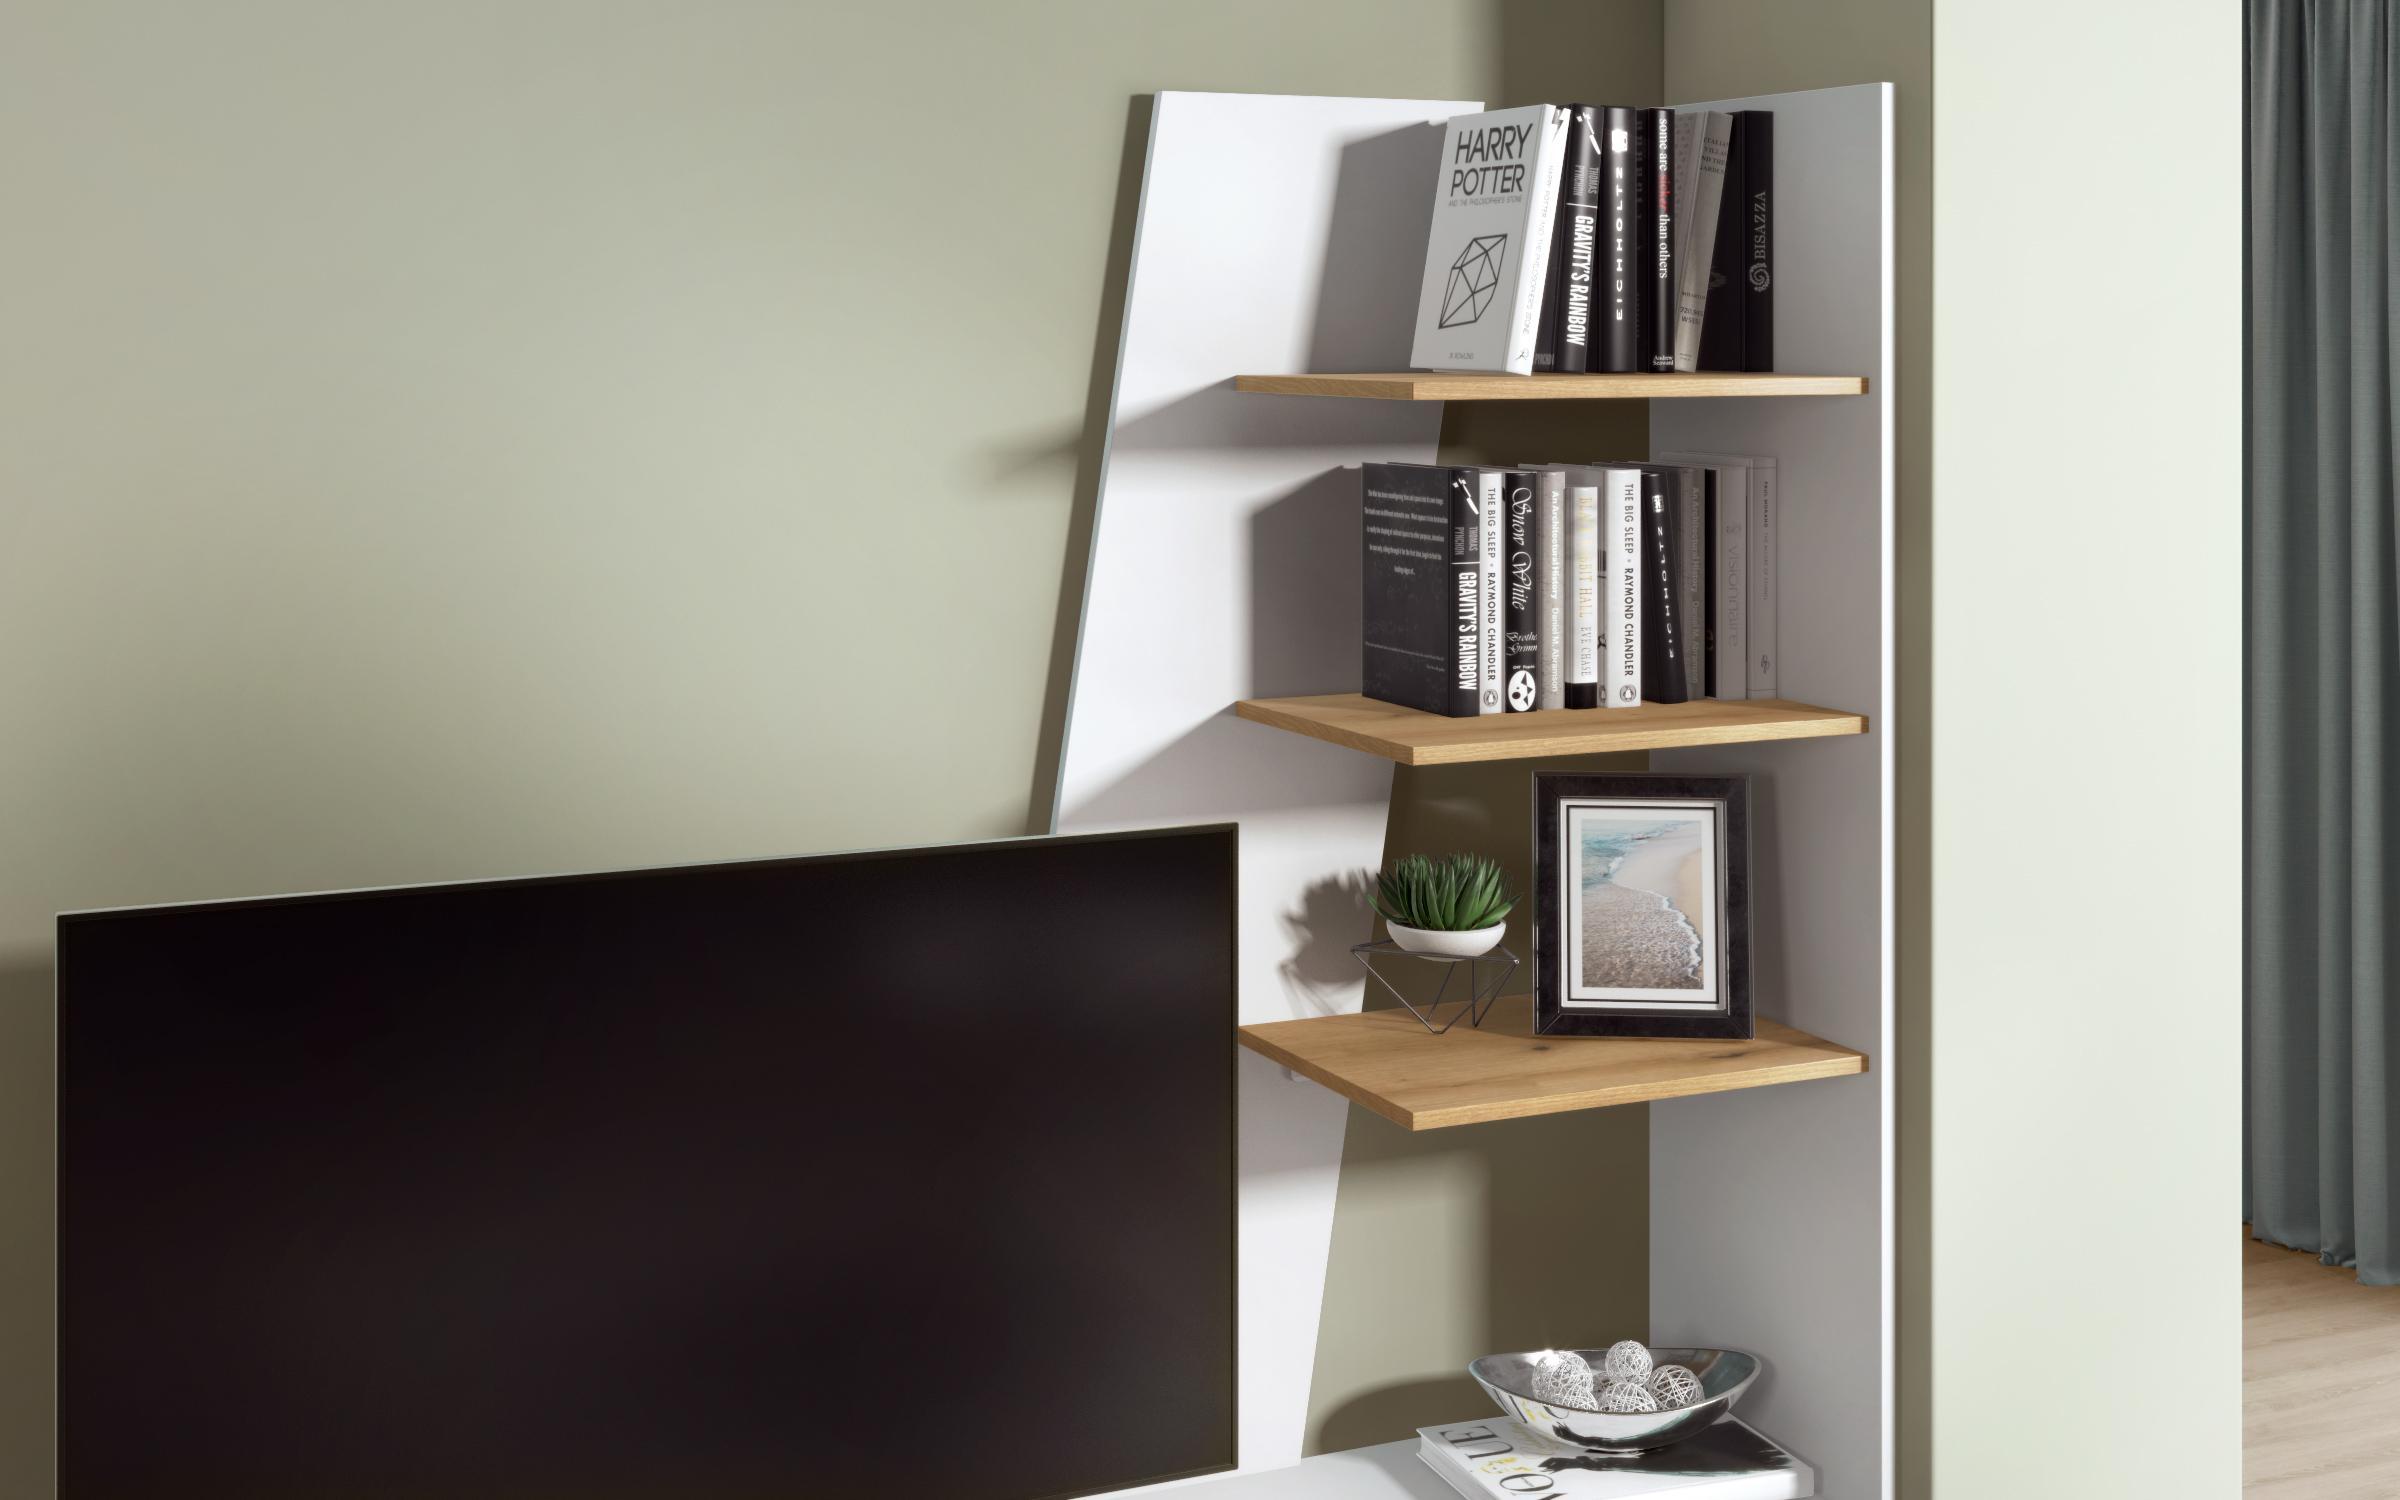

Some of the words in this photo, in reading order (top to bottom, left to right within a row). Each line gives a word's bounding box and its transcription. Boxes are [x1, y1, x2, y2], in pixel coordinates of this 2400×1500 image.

[1454, 122, 1532, 164] HARRY
[1658, 118, 1668, 150] some
[1658, 153, 1668, 171] are
[1450, 164, 1524, 197] POTTER
[1587, 166, 1599, 194] THOMAS
[1658, 214, 1670, 239] than
[1754, 191, 1766, 259] BISAZZA
[1572, 215, 1594, 281] GRAVITY'S
[1658, 242, 1670, 279] others
[1566, 284, 1588, 346] RAINBOW
[1487, 488, 1496, 505] THE
[1551, 490, 1559, 504] An
[1624, 483, 1634, 501] THE
[1487, 509, 1496, 527] BIG
[1511, 487, 1532, 546] Snow
[1624, 505, 1634, 523] BIG
[1454, 526, 1465, 556] PYNCHON
[1468, 526, 1478, 551] THOMAS
[1487, 531, 1496, 559] SLEEP
[1551, 505, 1560, 566] Architectural
[1624, 526, 1634, 554] SLEEP
[1511, 551, 1532, 611] White
[1550, 566, 1559, 600] History
[1624, 567, 1634, 620] RAYMOND
[1458, 571, 1477, 632] GRAVITY'S
[1487, 572, 1496, 624] RAYMOND
[1579, 588, 1592, 618] HALL
[1551, 607, 1559, 635] Daniel
[1580, 626, 1592, 645] EVE
[1459, 636, 1477, 690] RAINBOW
[1487, 628, 1496, 681] CHANDLER
[1580, 647, 1593, 676] CHASE
[1624, 623, 1634, 677] CHANDLER
